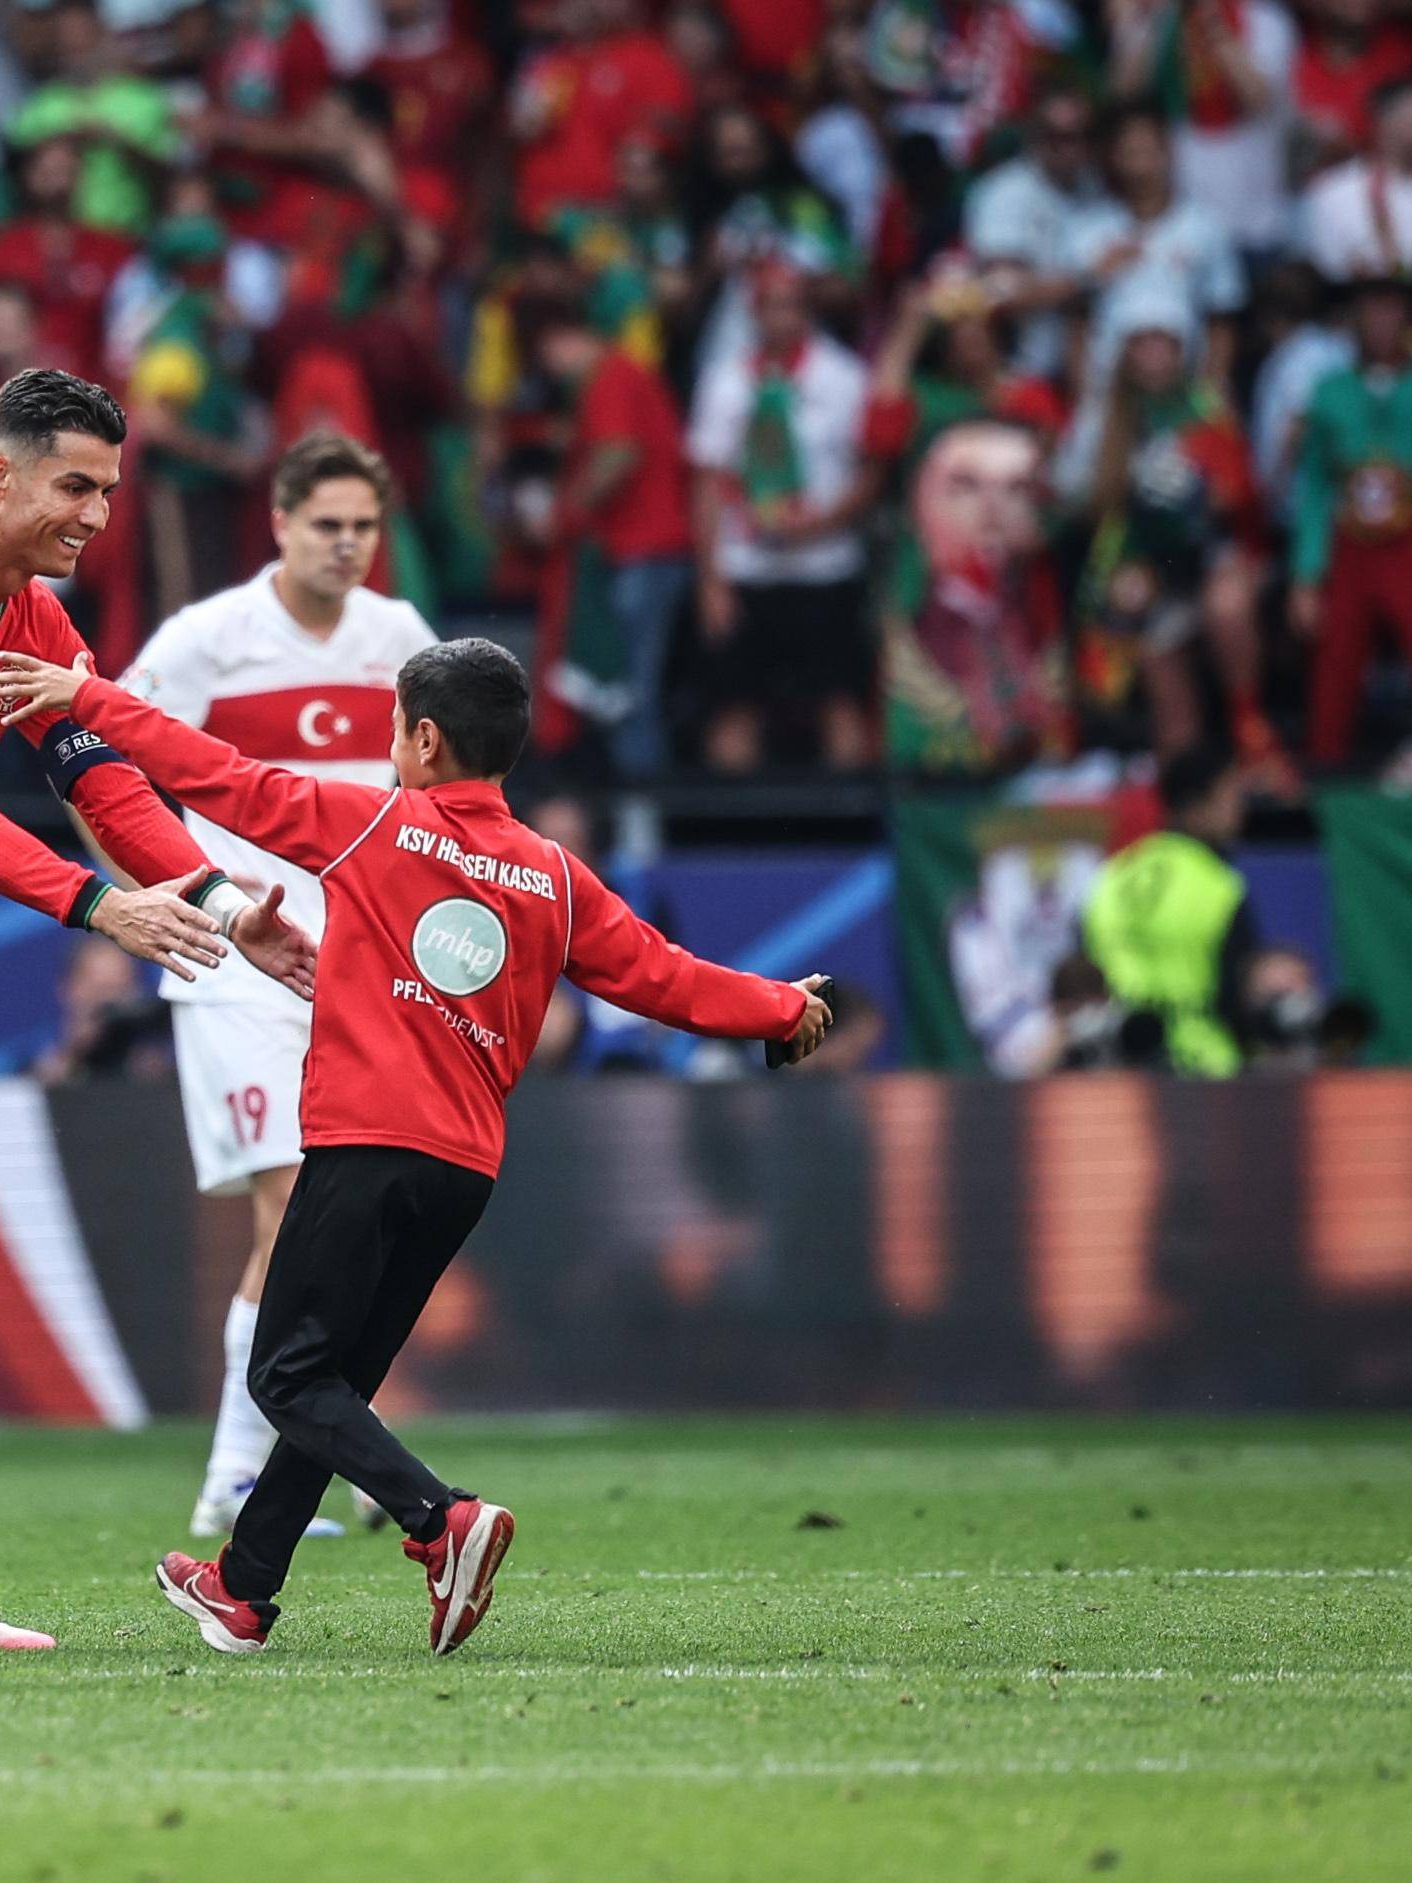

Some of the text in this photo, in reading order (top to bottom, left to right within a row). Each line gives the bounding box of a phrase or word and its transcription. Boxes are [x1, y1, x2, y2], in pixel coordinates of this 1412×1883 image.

[73, 734, 101, 749] RES
[395, 824, 437, 855] KSV
[498, 861, 557, 901] KASSEL
[426, 927, 494, 973] mhp
[226, 1086, 267, 1149] 19
